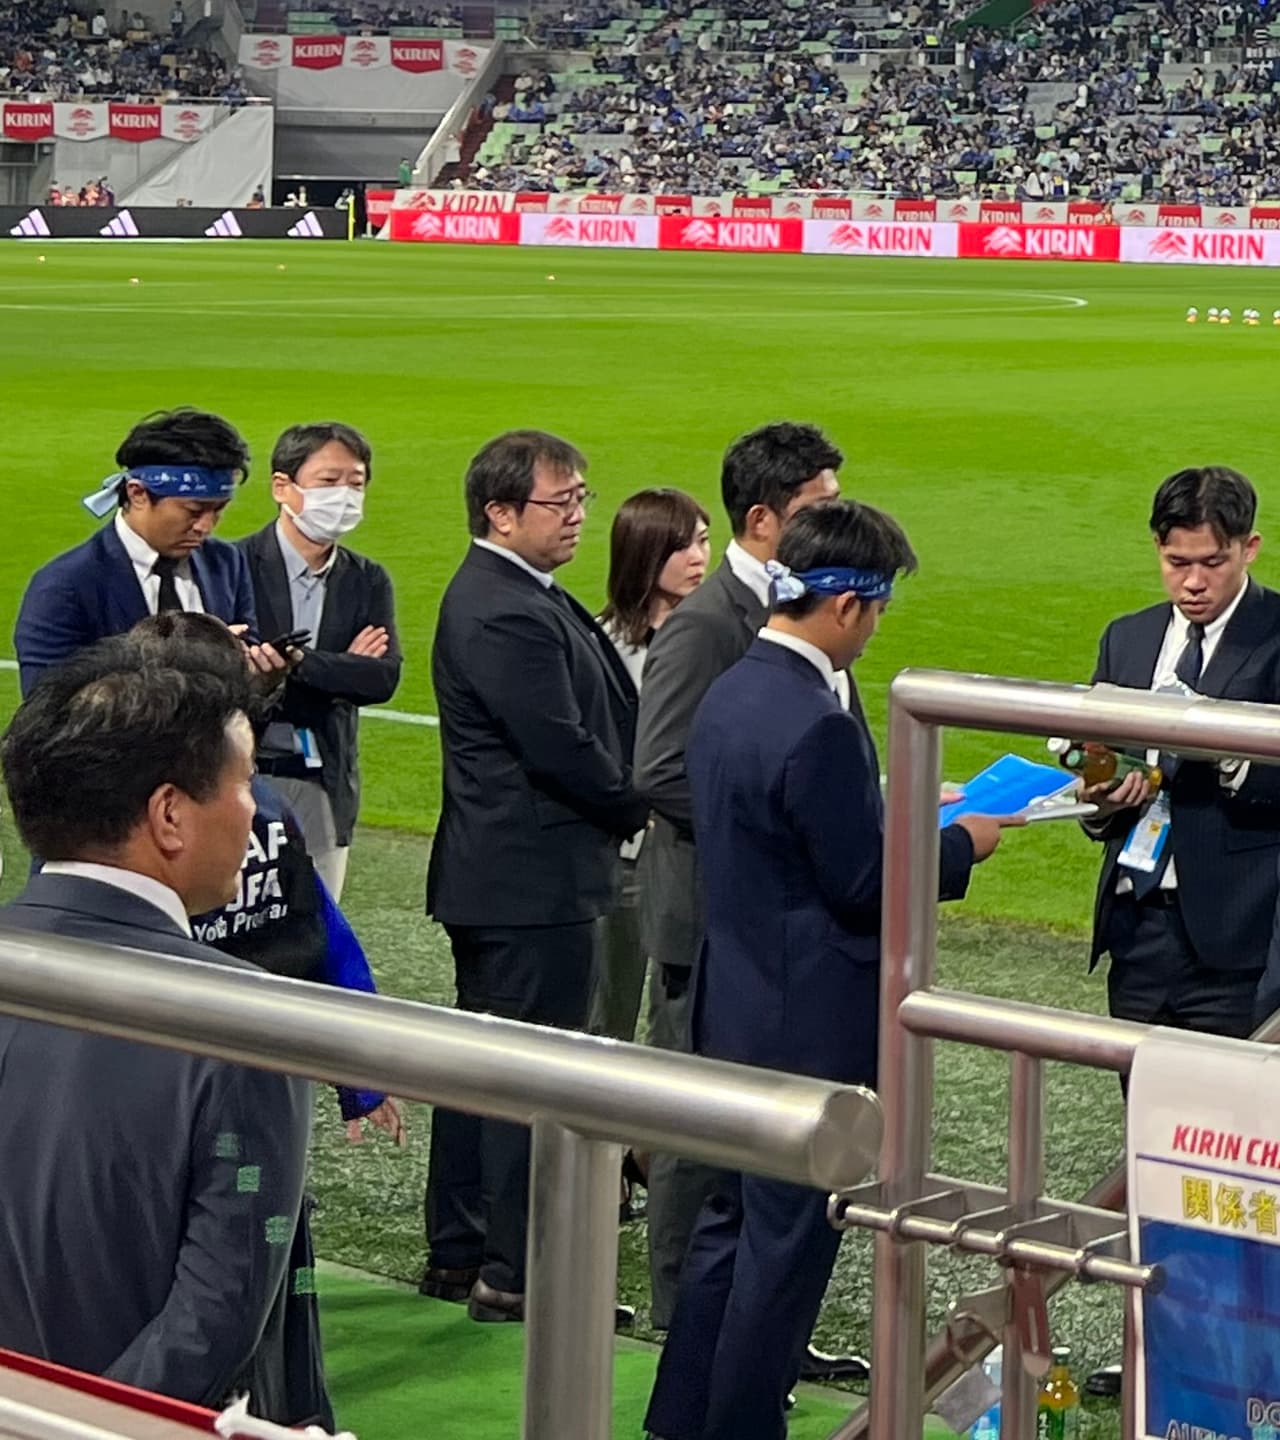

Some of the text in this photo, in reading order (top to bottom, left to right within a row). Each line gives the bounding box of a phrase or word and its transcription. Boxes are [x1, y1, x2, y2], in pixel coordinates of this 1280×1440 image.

[295, 43, 343, 58] KIRIN
[392, 47, 441, 61] KIRIN
[5, 112, 50, 127] KIRIN
[111, 113, 159, 128] KIRIN
[444, 215, 500, 239] KIRIN
[579, 215, 636, 243] KIRIN
[717, 219, 780, 247] KIRIN
[867, 224, 932, 253] KIRIN
[1025, 228, 1095, 257] KIRIN
[1192, 231, 1264, 261] KIRIN
[1172, 1123, 1241, 1161] KIRIN
